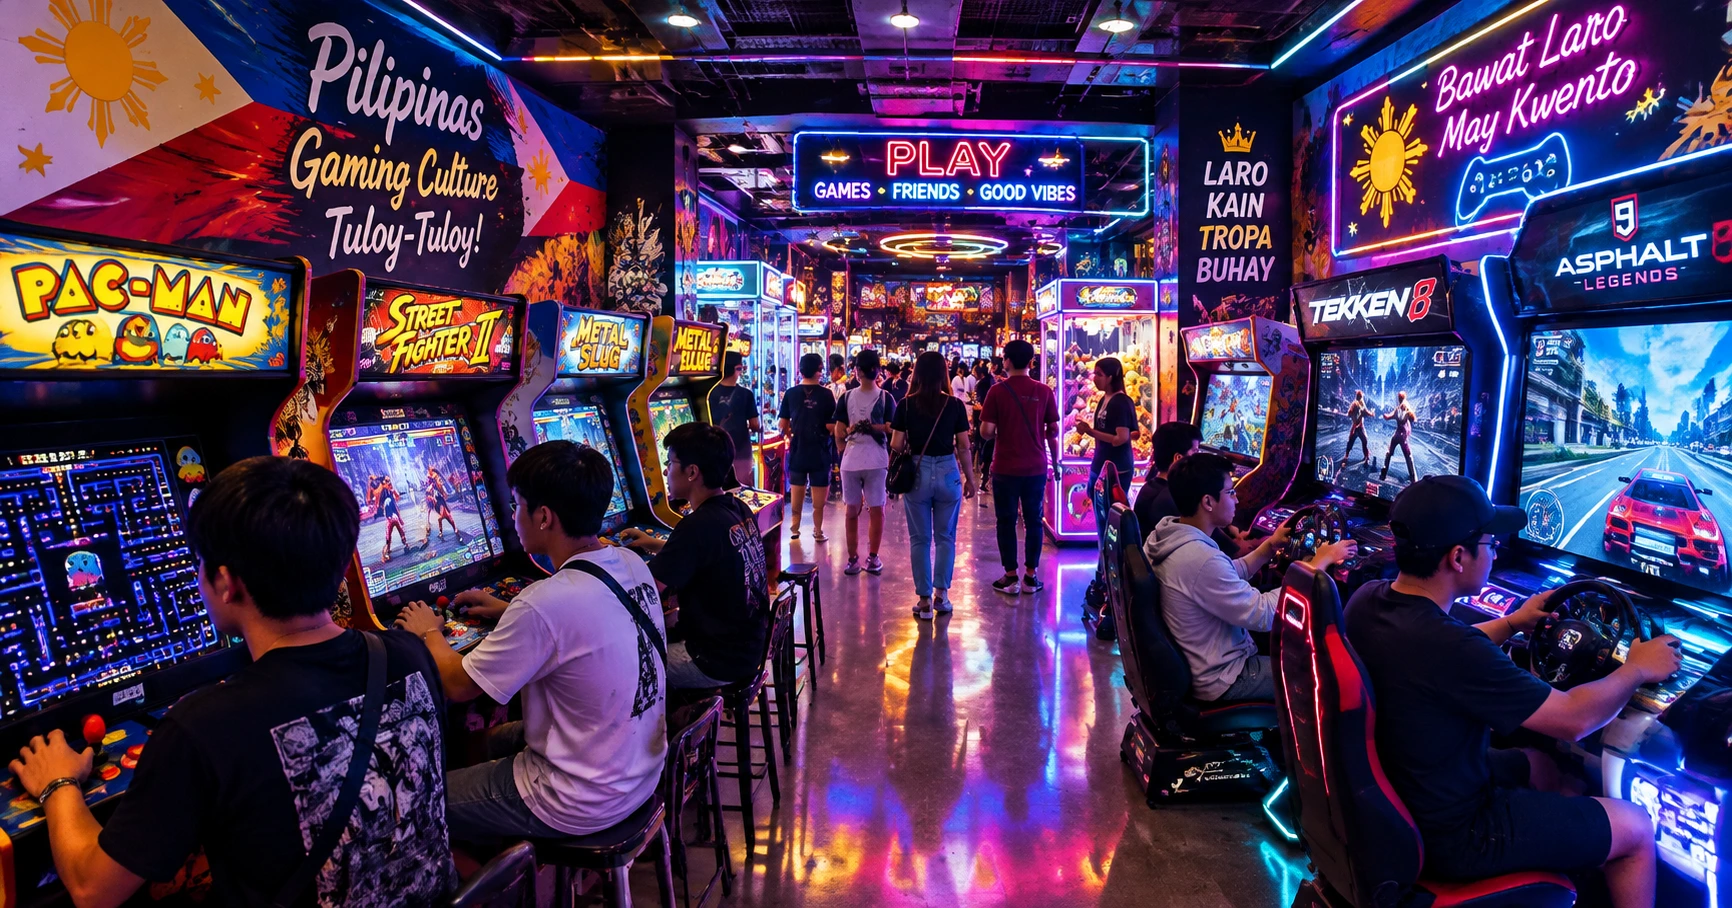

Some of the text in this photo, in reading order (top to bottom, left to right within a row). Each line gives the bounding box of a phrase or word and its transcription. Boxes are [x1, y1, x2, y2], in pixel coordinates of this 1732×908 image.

[1435, 5, 1627, 113] Bawat Laro
[308, 22, 484, 146] Pilipinas
[1437, 51, 1636, 158] May Kwento
[289, 127, 499, 210] Gaming Culture
[886, 141, 1011, 177] PLAY
[1203, 161, 1268, 186] LARO
[814, 181, 1076, 202] GAMES FRIENDS GOOD VIBES
[1206, 192, 1265, 218] KAIN
[325, 205, 483, 272] Tuloy-Tuloy!
[1199, 224, 1272, 250] TROPA
[1555, 233, 1707, 277] ASPHALT
[1196, 256, 1275, 283] BUHAY
[1584, 267, 1679, 291] LEGENDS
[11, 258, 252, 336] PAC-MAN
[1308, 277, 1437, 326] TEKKEN 8
[375, 293, 462, 346] STREET
[570, 315, 629, 350] METAL
[674, 326, 713, 353] METAL
[389, 309, 504, 374] FIGHTER II
[577, 343, 621, 371] SLUG
